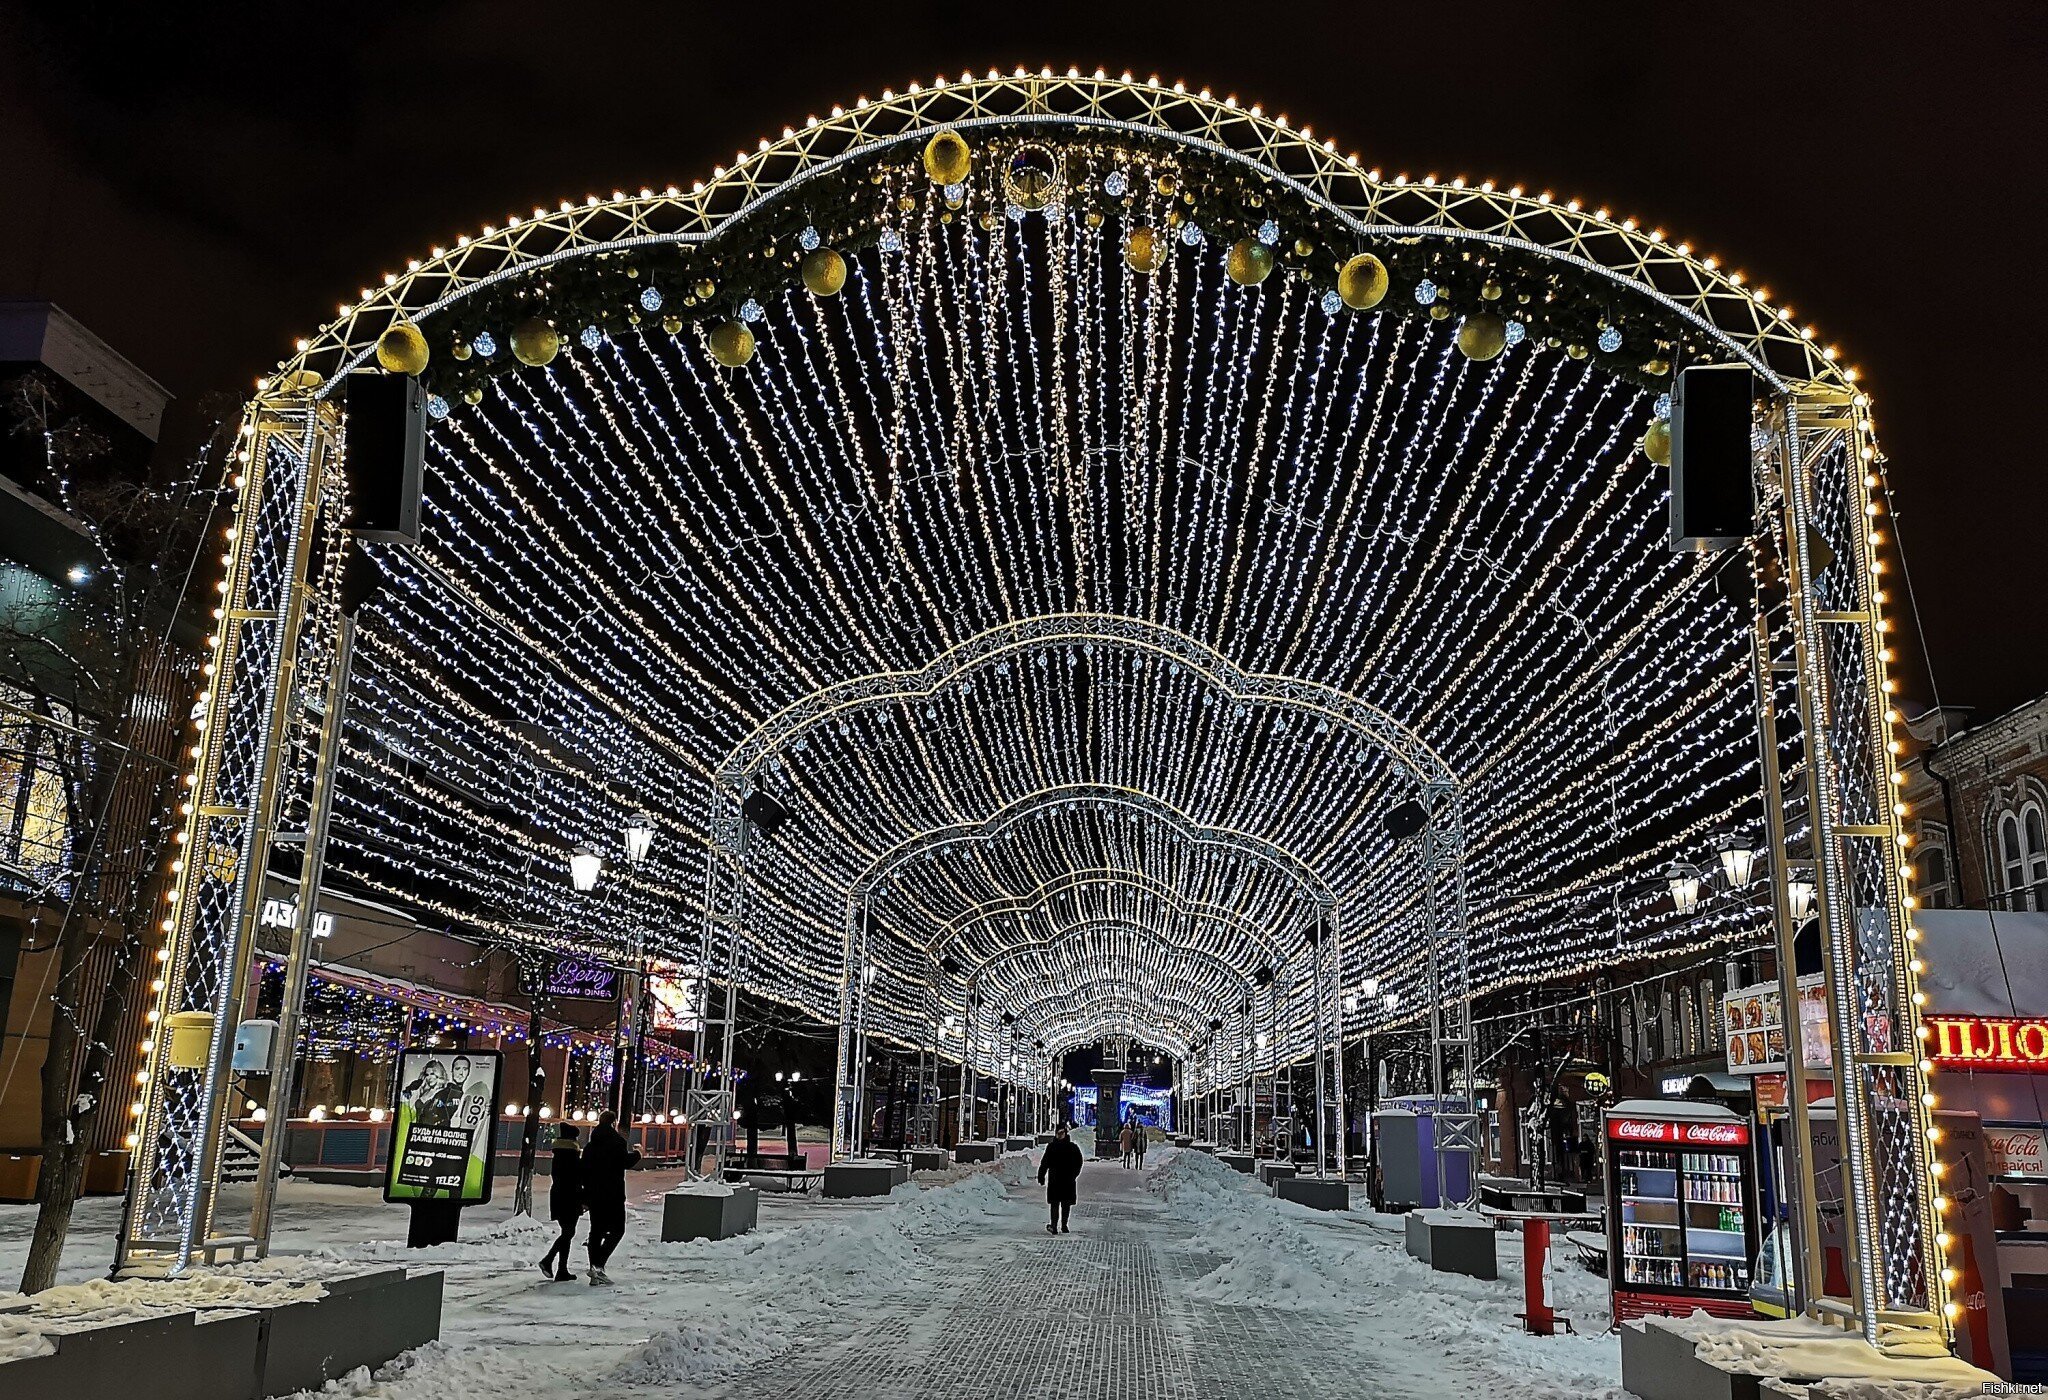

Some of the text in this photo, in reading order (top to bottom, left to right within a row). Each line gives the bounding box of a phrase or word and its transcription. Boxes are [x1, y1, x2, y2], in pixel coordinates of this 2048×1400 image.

[584, 988, 612, 998] DINER
[466, 1095, 485, 1125] SOS
[412, 1126, 467, 1139] БУДЬ НА ВОЛНЕ
[1618, 1121, 1665, 1139] Coca-Cola
[410, 1134, 468, 1148] ДАЖЕ ПРИ НУЛЕ
[435, 1175, 461, 1187] TELE2
